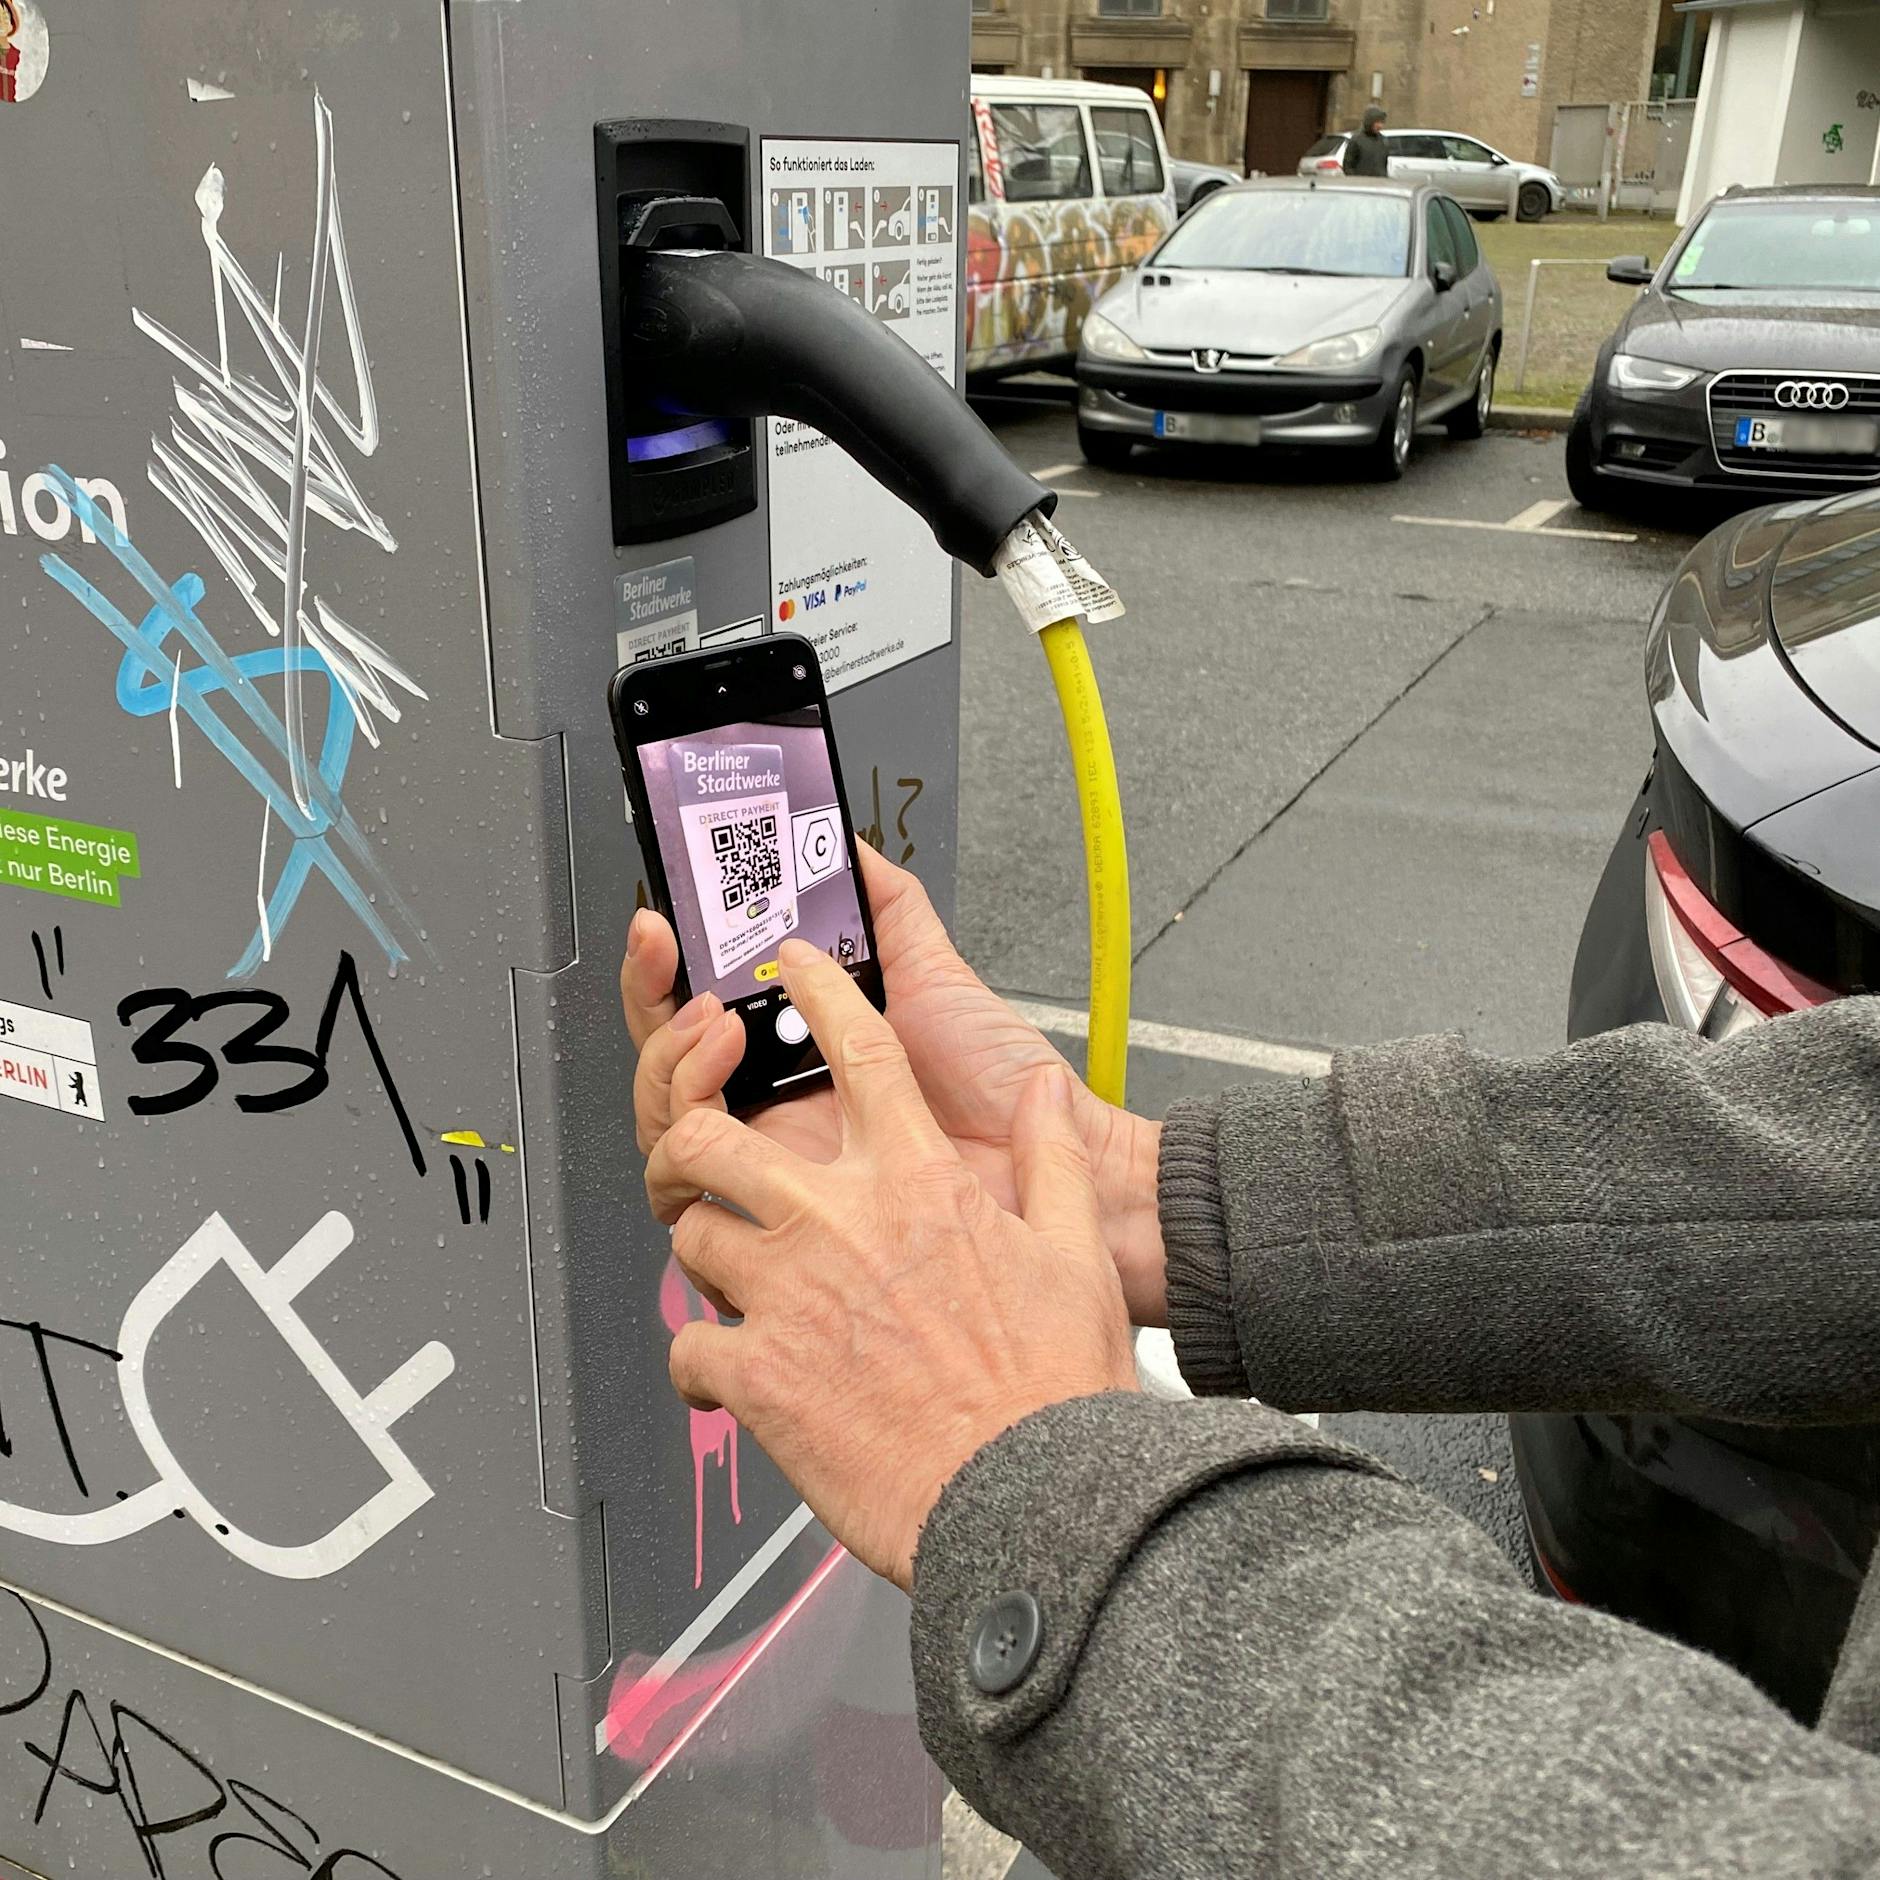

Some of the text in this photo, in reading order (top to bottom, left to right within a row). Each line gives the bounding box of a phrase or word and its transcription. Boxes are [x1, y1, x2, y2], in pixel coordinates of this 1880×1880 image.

[770, 156, 875, 171] So funktioniert das Laden:
[775, 420, 795, 435] Oder
[1752, 422, 1765, 441] B
[623, 575, 668, 602] Berliner
[778, 557, 868, 595] Zahlungsmöglichkeiten:
[630, 586, 692, 621] Stadtwerke
[803, 590, 826, 611] VISA
[844, 579, 868, 597] PayPal
[628, 622, 691, 650] DIRECT PAYMENT
[829, 622, 858, 641] Service:
[684, 750, 751, 773] Berliner
[697, 769, 781, 795] Stadtwerke
[699, 802, 780, 825] DIRECT PAYMENT
[45, 825, 131, 867] Energie
[815, 835, 826, 857] C
[8, 860, 113, 897] nur Berlin
[746, 998, 768, 1011] VIDEO
[0, 1059, 48, 1089] RLIN
